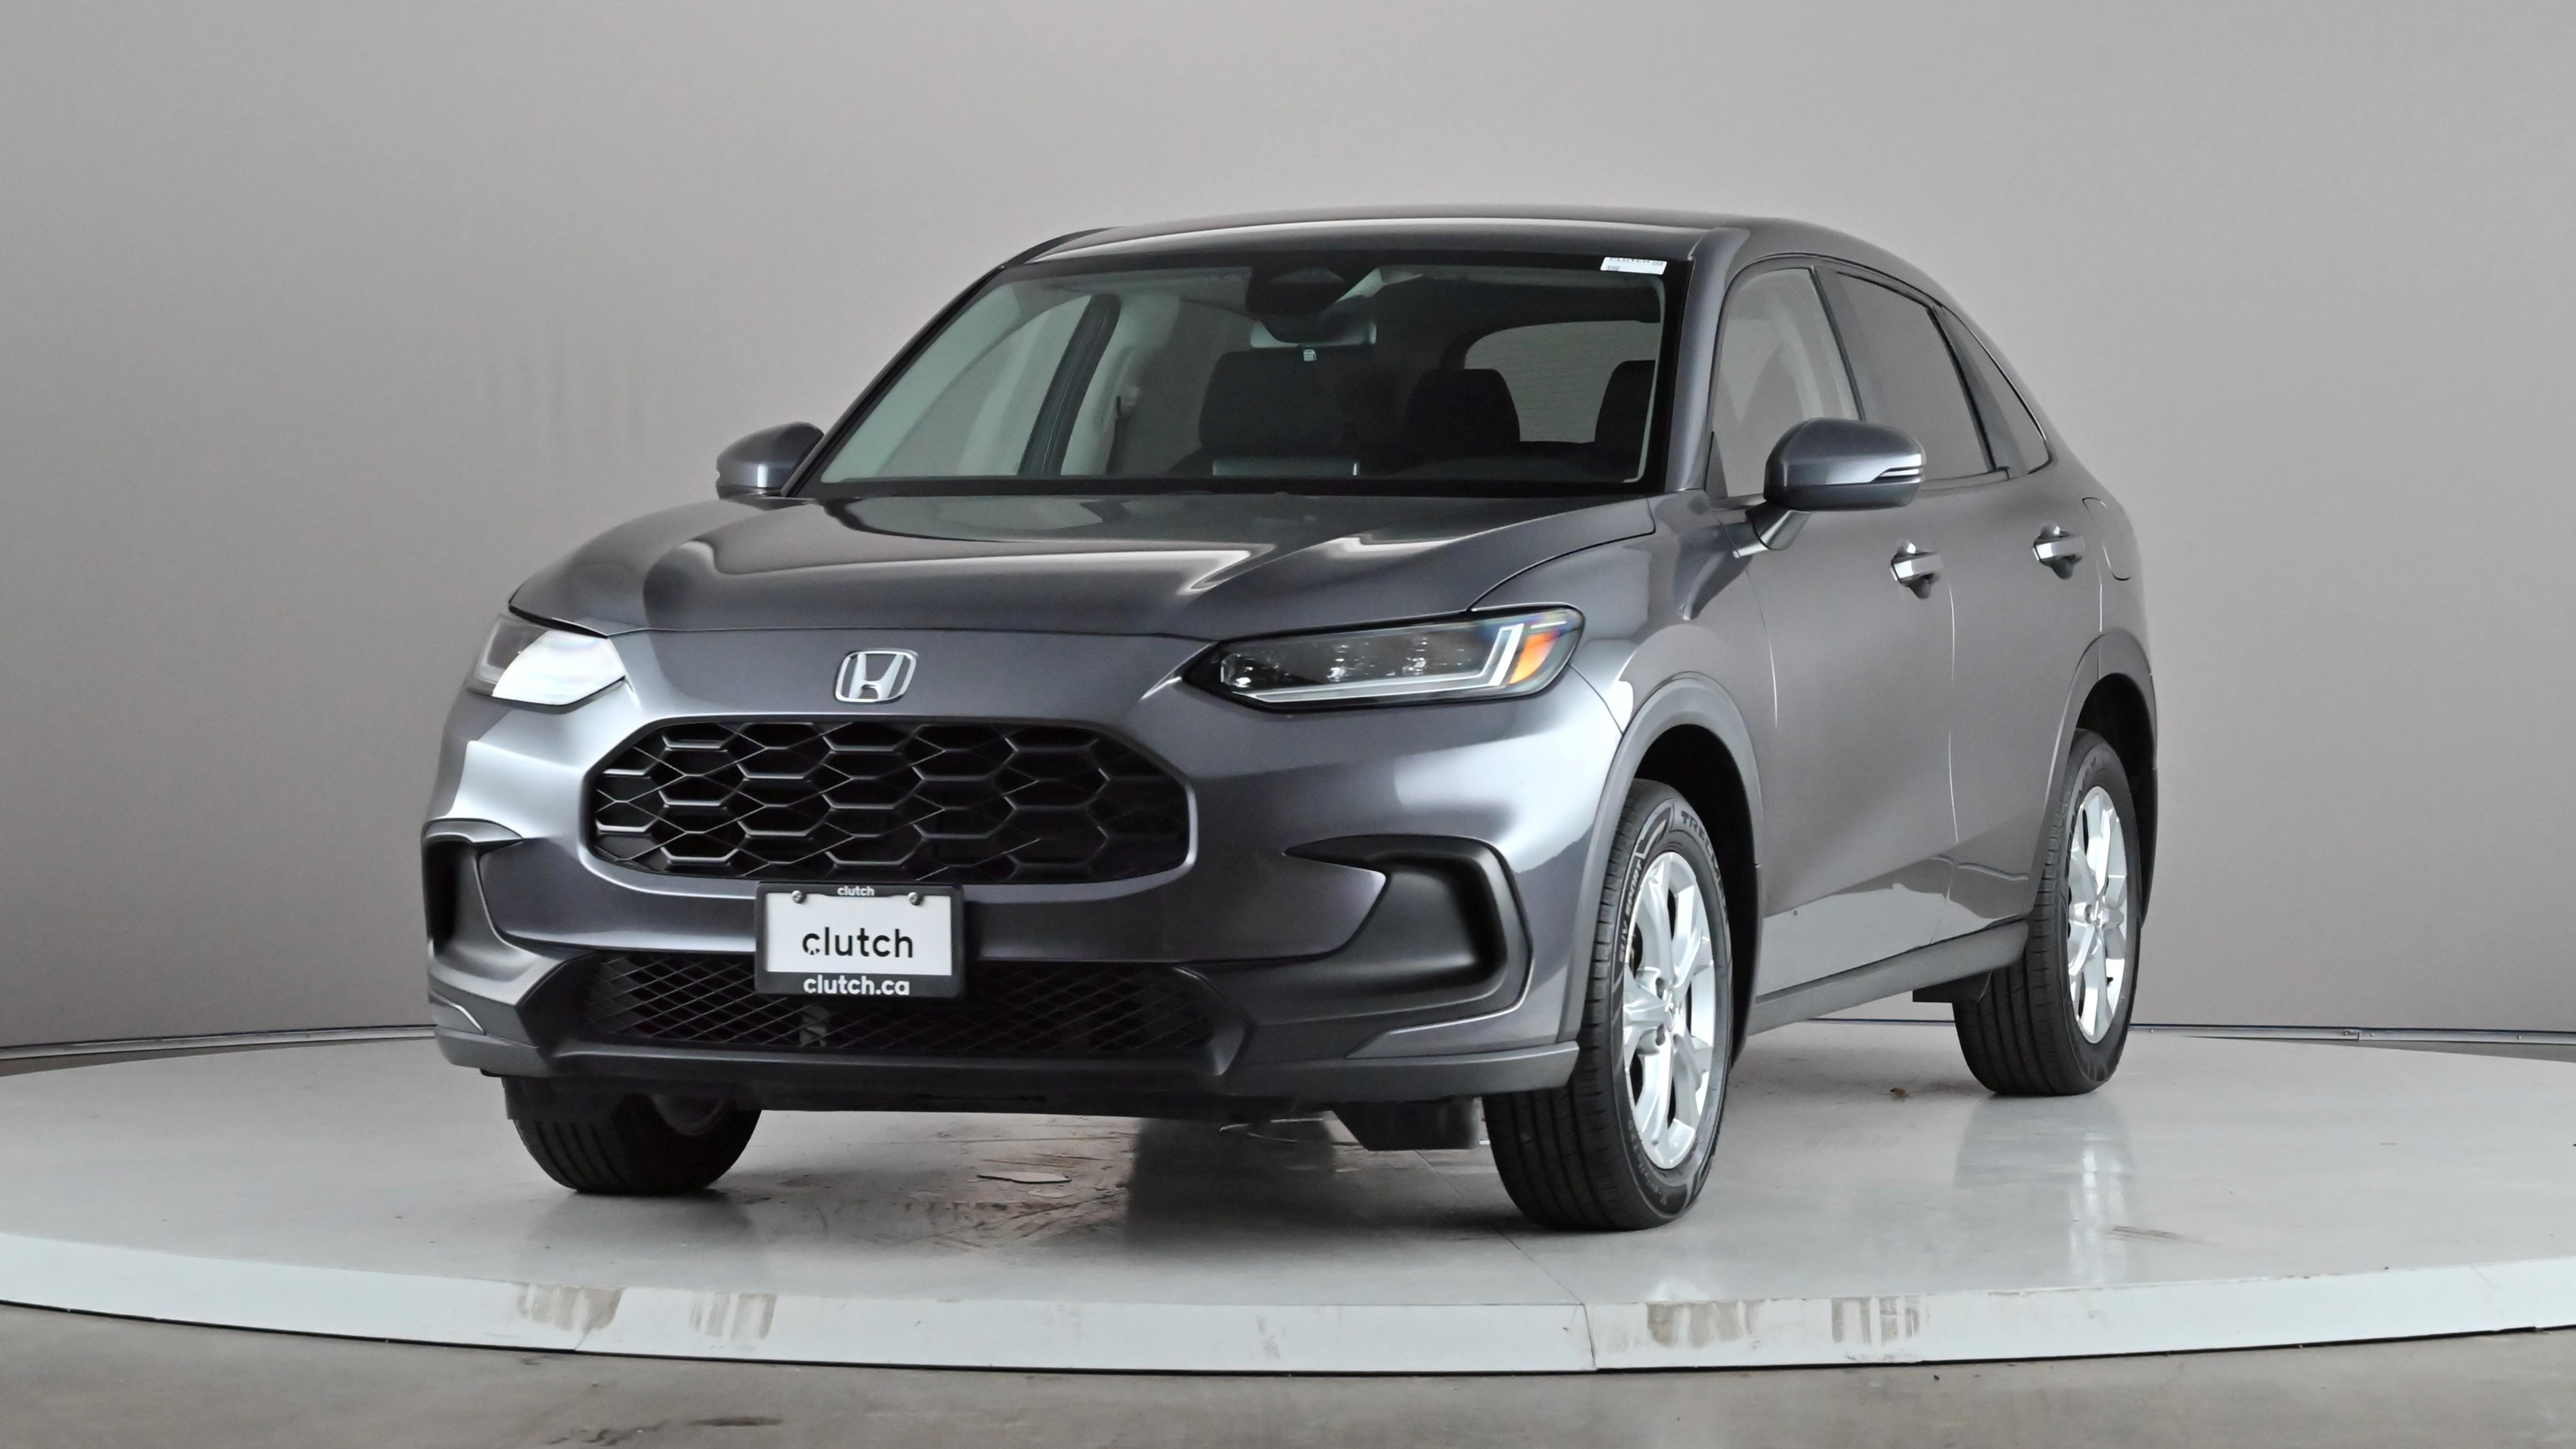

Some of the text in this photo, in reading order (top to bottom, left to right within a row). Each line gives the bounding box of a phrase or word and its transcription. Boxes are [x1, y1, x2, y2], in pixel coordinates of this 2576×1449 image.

[837, 886, 875, 897] clutch
[802, 927, 913, 958] clutch
[803, 975, 909, 995] clutch.ca
